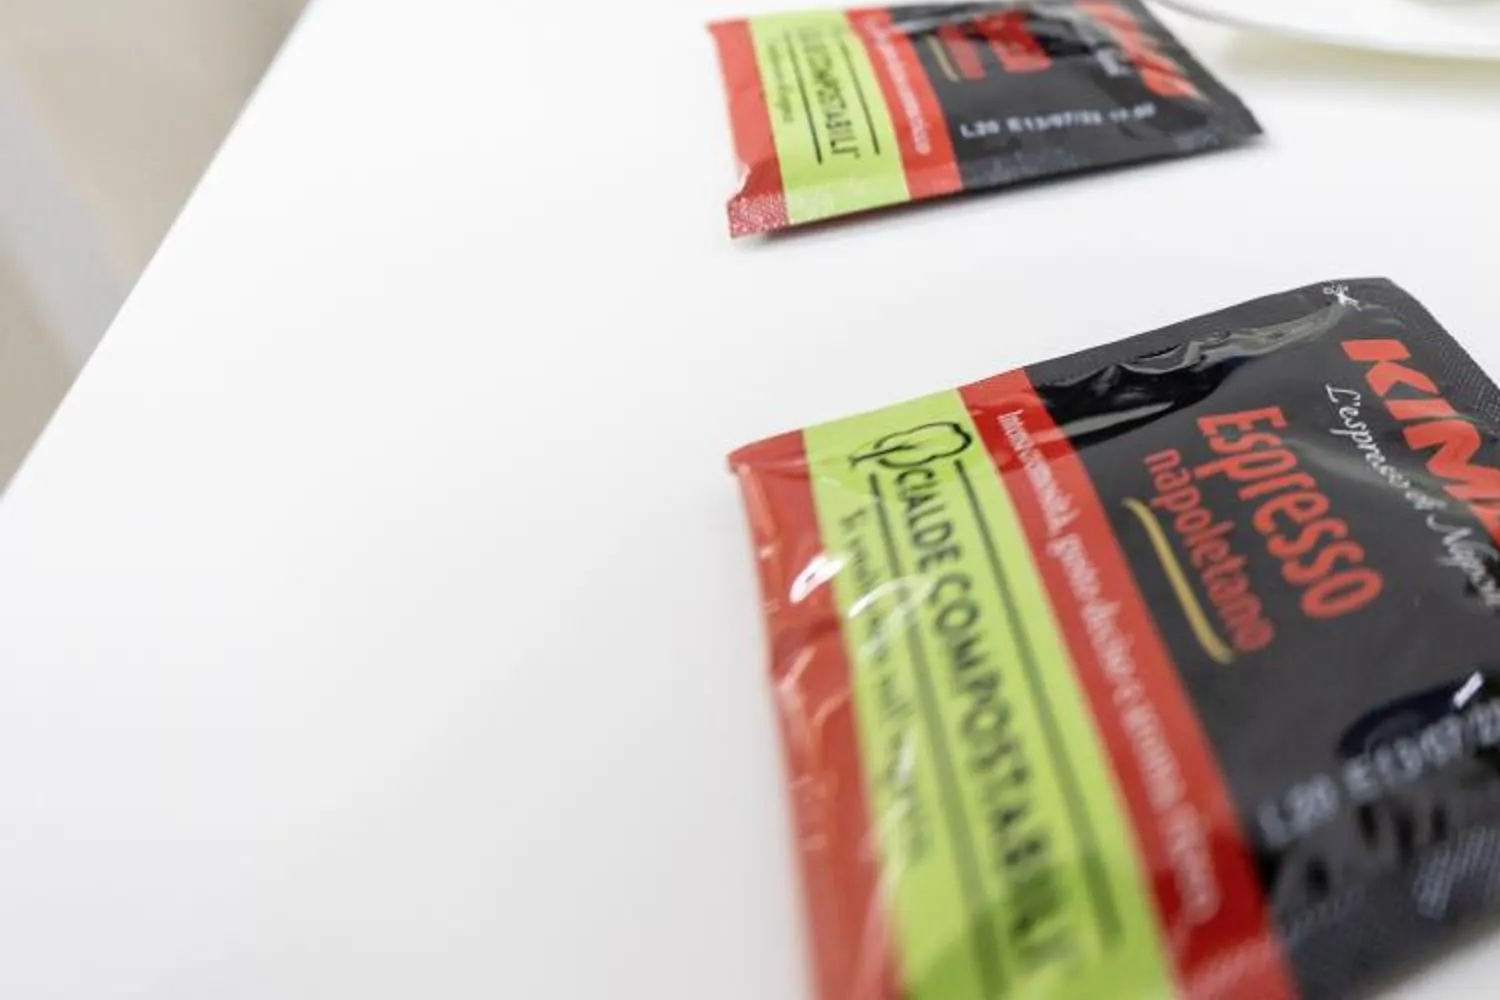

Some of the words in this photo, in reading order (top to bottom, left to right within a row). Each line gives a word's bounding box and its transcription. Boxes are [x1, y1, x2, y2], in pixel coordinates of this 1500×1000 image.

[893, 467, 963, 571] CIALDE
[1143, 448, 1275, 651] napoletano
[1194, 406, 1384, 618] Espresso
